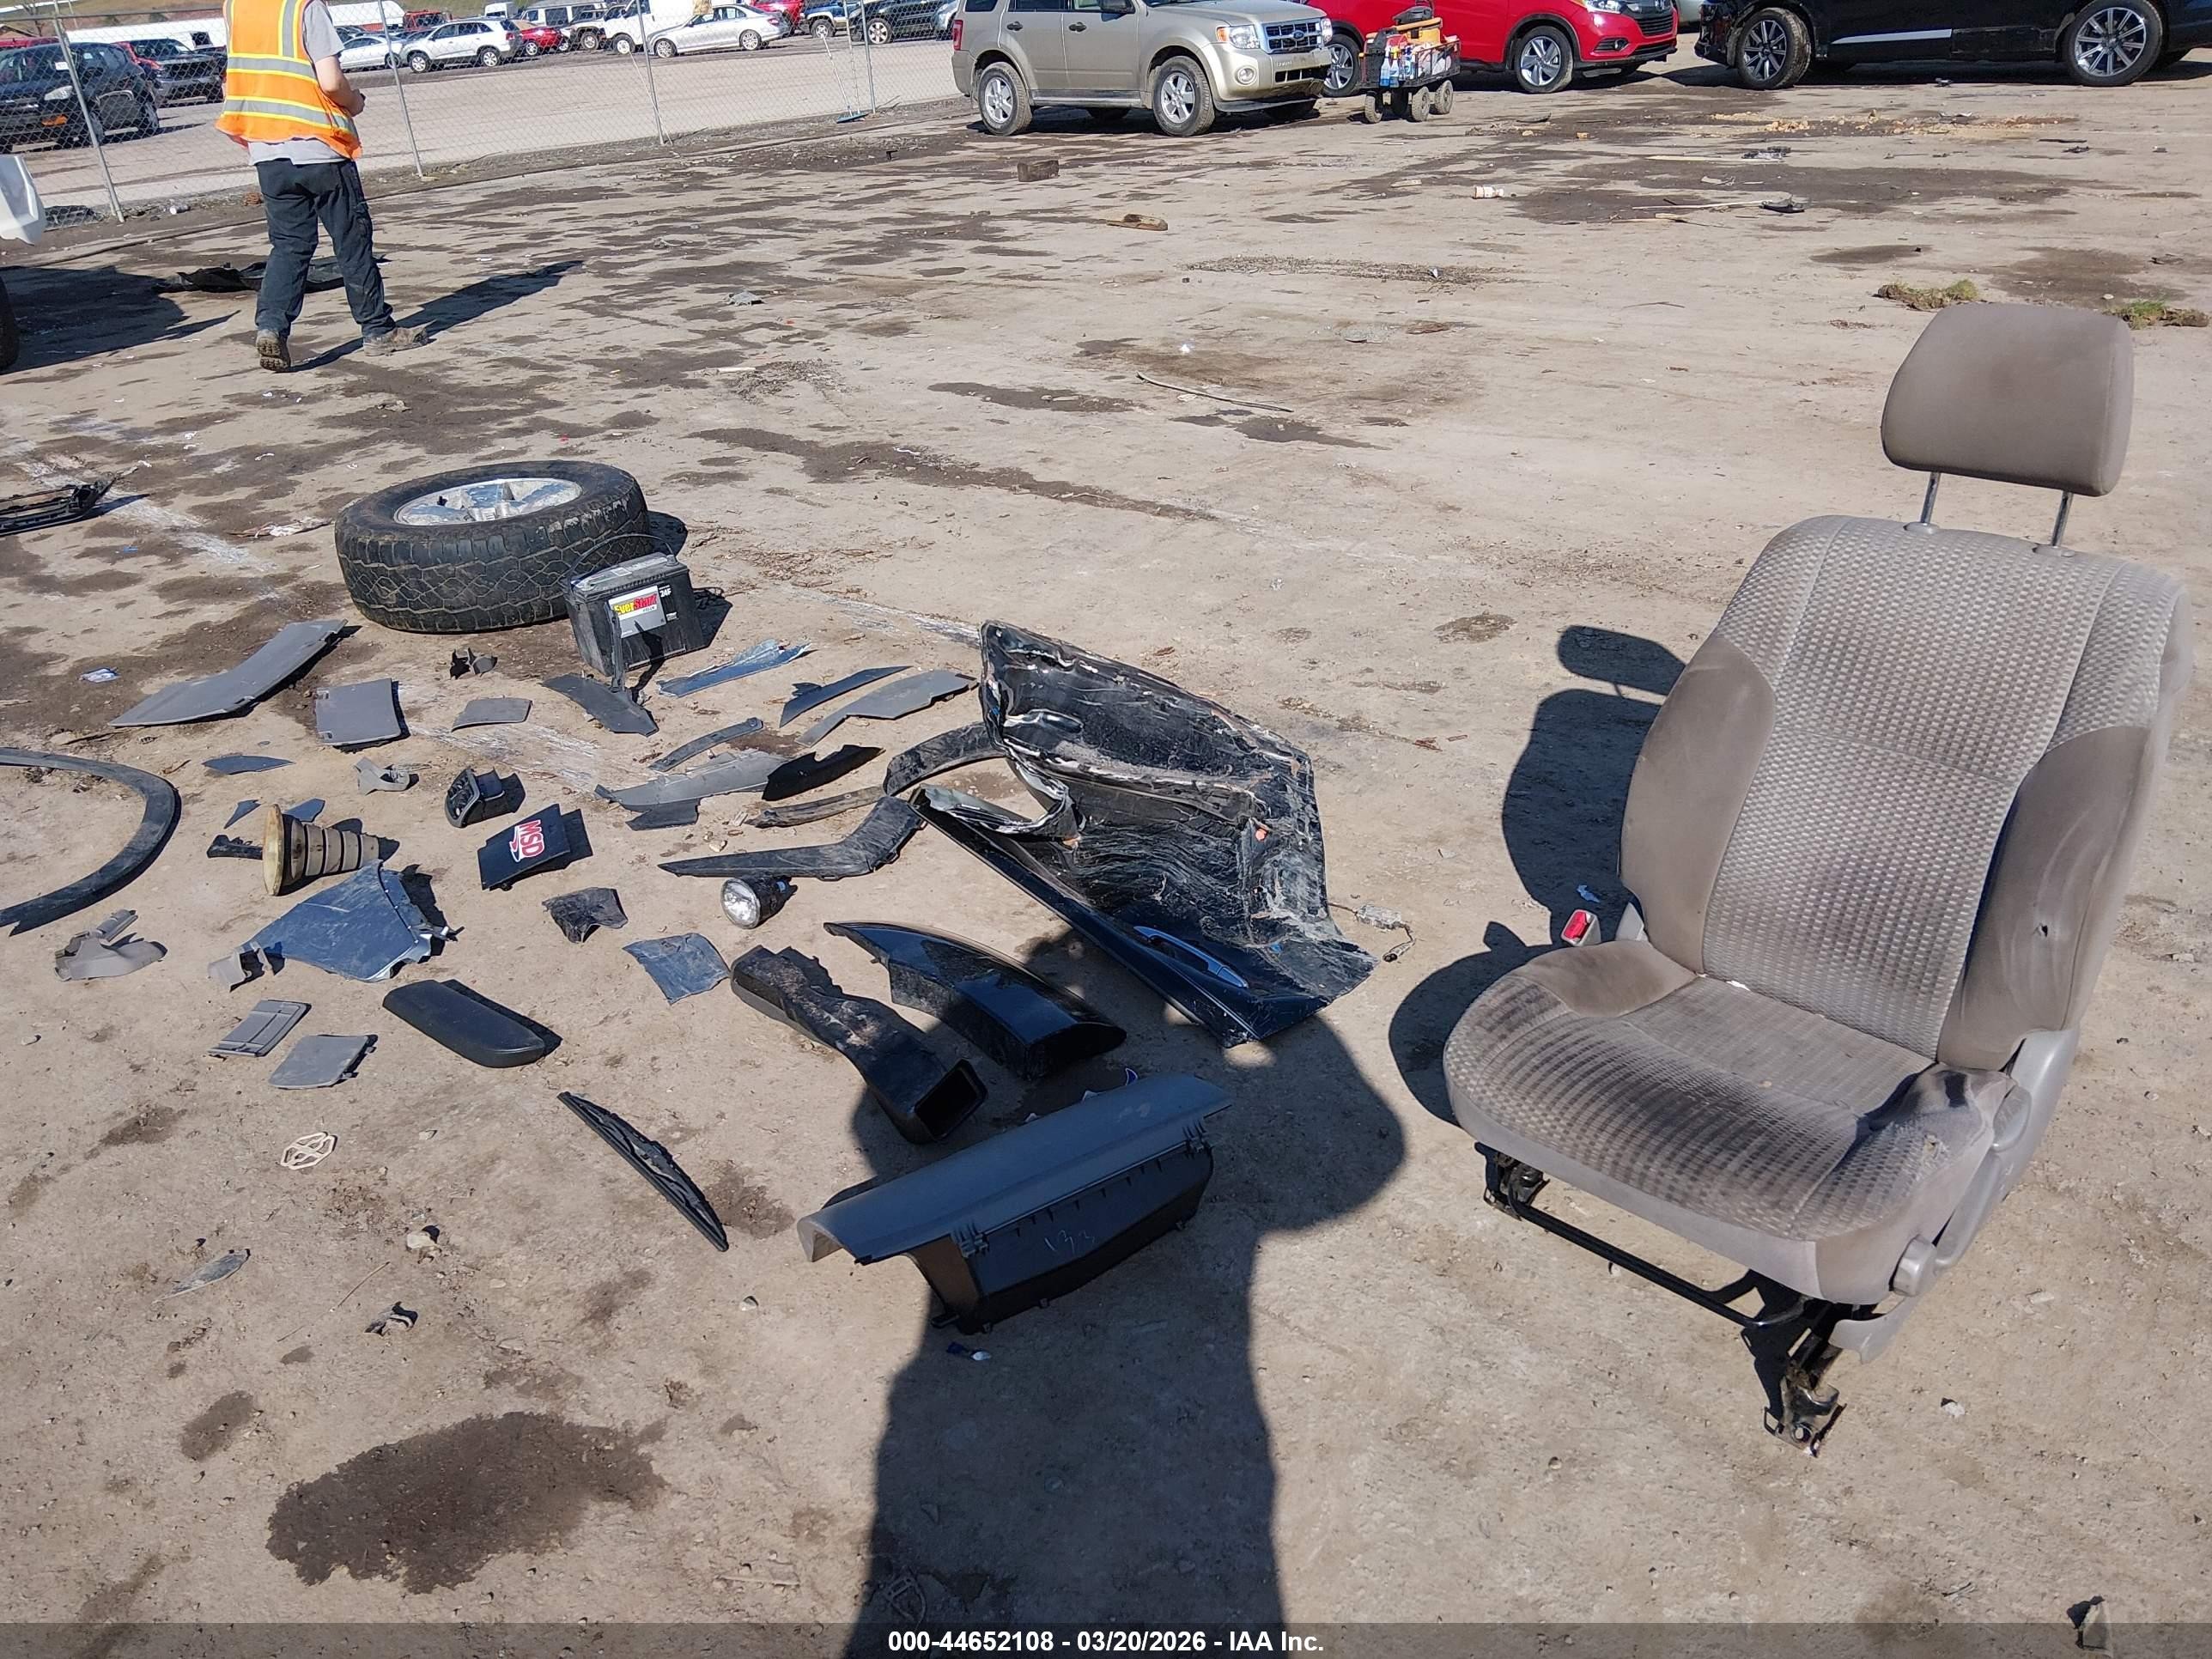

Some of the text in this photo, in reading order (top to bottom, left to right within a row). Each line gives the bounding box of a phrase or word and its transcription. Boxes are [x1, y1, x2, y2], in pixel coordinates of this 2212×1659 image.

[614, 592, 658, 615] EverStart
[659, 588, 672, 598] 24F
[518, 819, 544, 857] MSD
